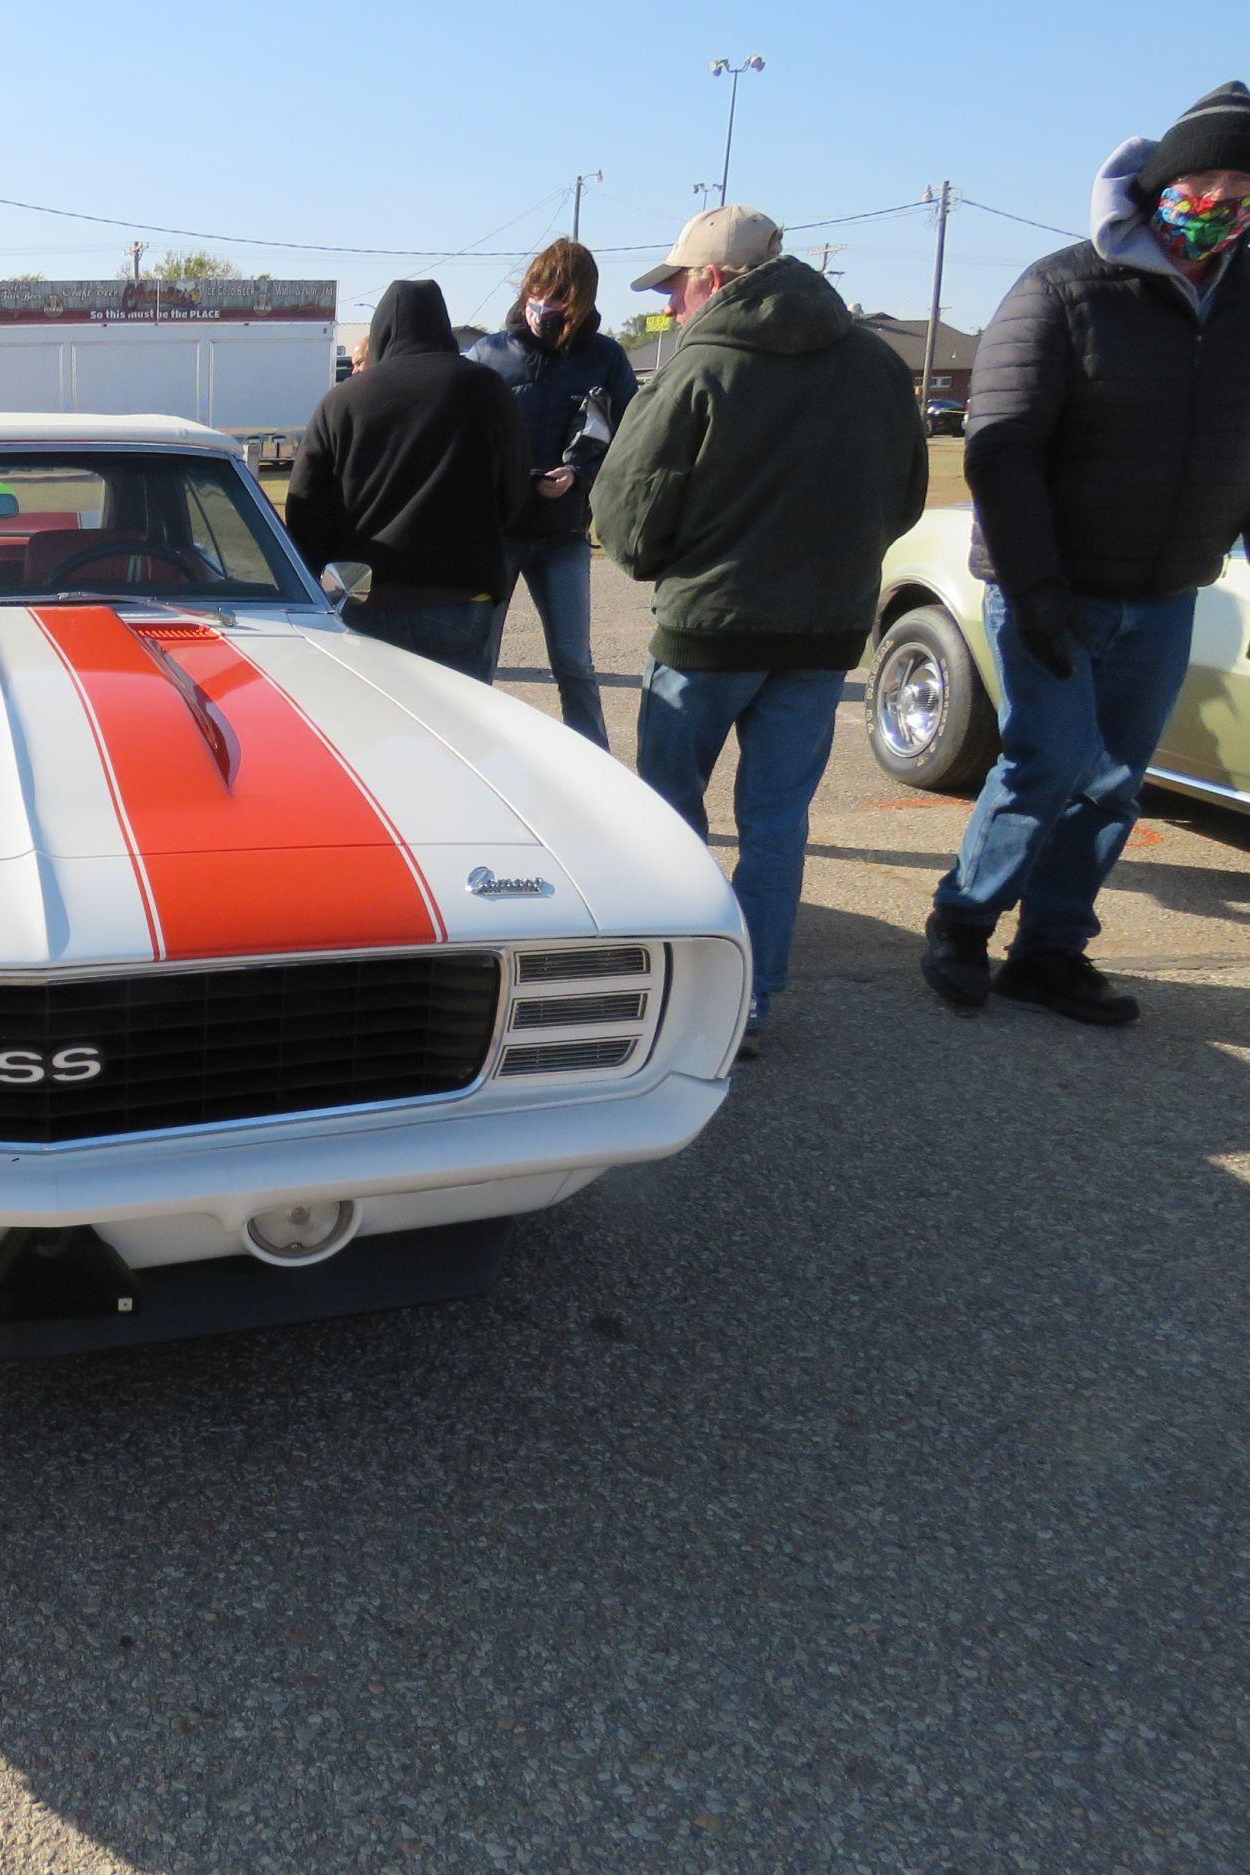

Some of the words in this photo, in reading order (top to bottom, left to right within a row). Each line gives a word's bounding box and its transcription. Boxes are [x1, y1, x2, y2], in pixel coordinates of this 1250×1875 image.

[90, 310, 103, 319] So
[106, 309, 126, 319] this
[128, 309, 154, 319] must
[171, 309, 188, 319] the
[189, 310, 221, 319] PLACE
